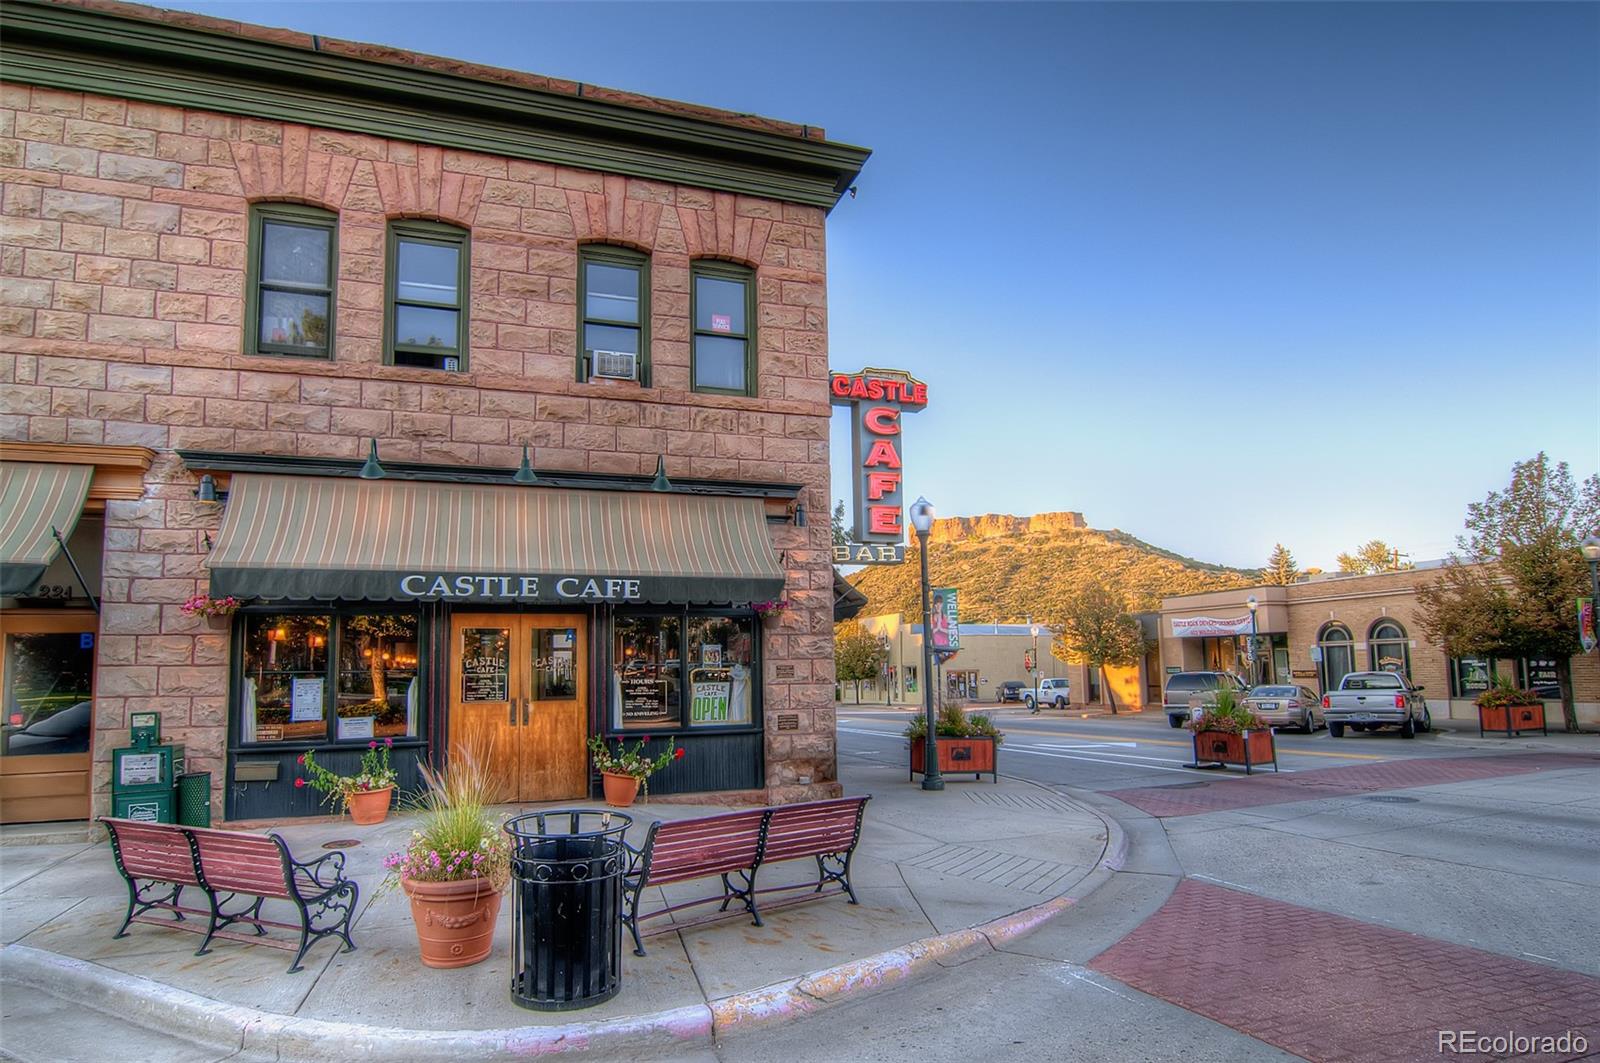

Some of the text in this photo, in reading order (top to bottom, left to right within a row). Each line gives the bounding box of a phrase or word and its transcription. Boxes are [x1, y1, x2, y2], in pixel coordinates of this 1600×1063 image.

[832, 375, 928, 404] CASTLE
[863, 406, 902, 535] CAFE
[832, 545, 902, 562] BAR
[40, 585, 72, 600] 221
[400, 575, 641, 599] CASTLE CAFE
[947, 592, 958, 647] WELLNESS
[80, 633, 94, 648] B
[566, 628, 577, 642] A
[465, 656, 505, 669] CASTLE
[535, 656, 572, 668] CAST
[696, 684, 727, 692] CASTLE
[693, 697, 728, 720] OPEN
